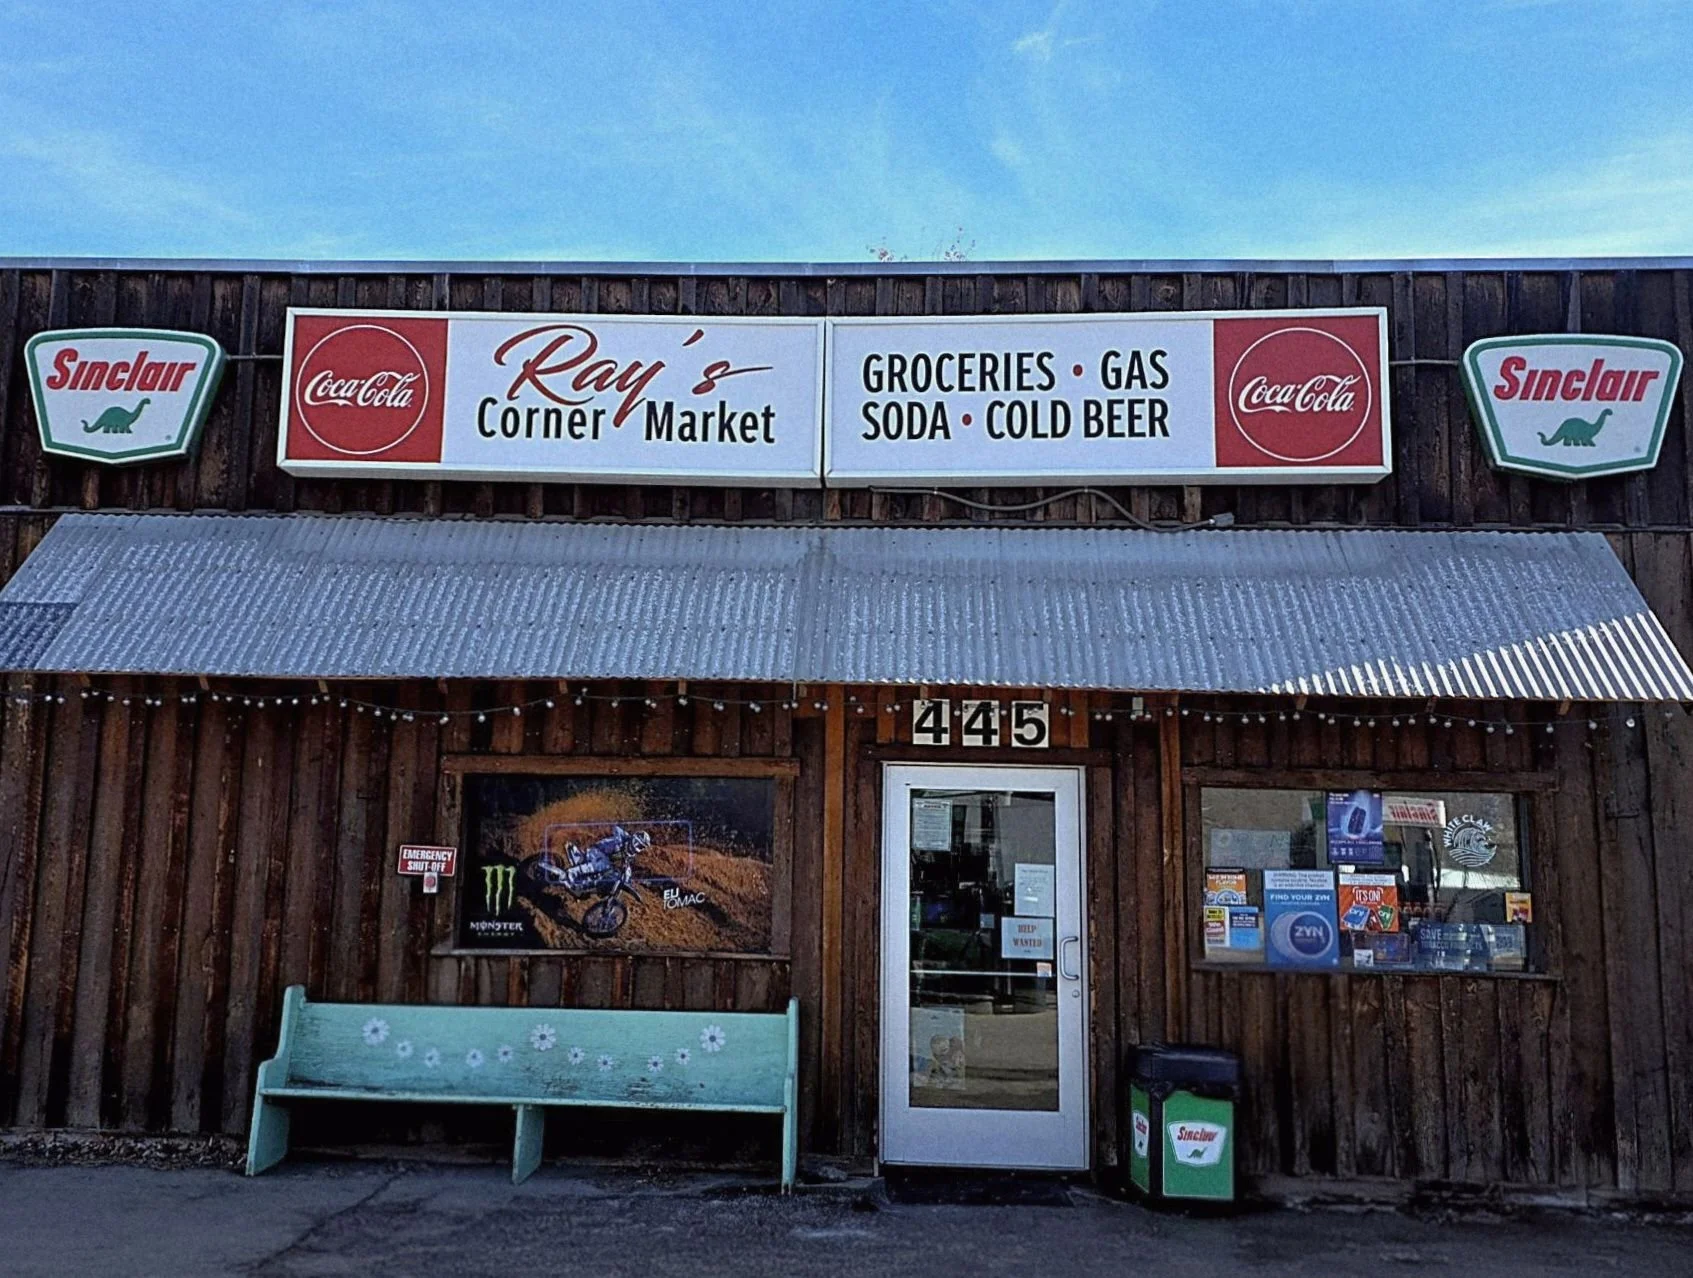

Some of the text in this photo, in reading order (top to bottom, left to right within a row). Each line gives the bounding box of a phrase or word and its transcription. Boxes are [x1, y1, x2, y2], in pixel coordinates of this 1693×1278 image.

[46, 348, 197, 392] Sinclair
[304, 369, 421, 408] Coca-Cola
[494, 324, 774, 428] Ray's
[862, 349, 1169, 393] GROCERIES GAS
[1493, 355, 1660, 402] Sinclair
[1238, 374, 1362, 413] Coca-Cola
[477, 396, 776, 444] Corner Market
[861, 397, 1170, 441] SODA COLD BEER
[914, 700, 1047, 746] 445
[1442, 814, 1493, 848] WHITE CLAW
[402, 848, 453, 861] EMERGENCY
[407, 860, 447, 872] SHUT-OFF
[1270, 893, 1290, 901] FIND
[1291, 893, 1313, 901] YOUR
[469, 920, 524, 931] MONSTER
[1012, 937, 1043, 948] WANTED
[1016, 923, 1037, 934] HELP
[1294, 925, 1325, 939] ZYN
